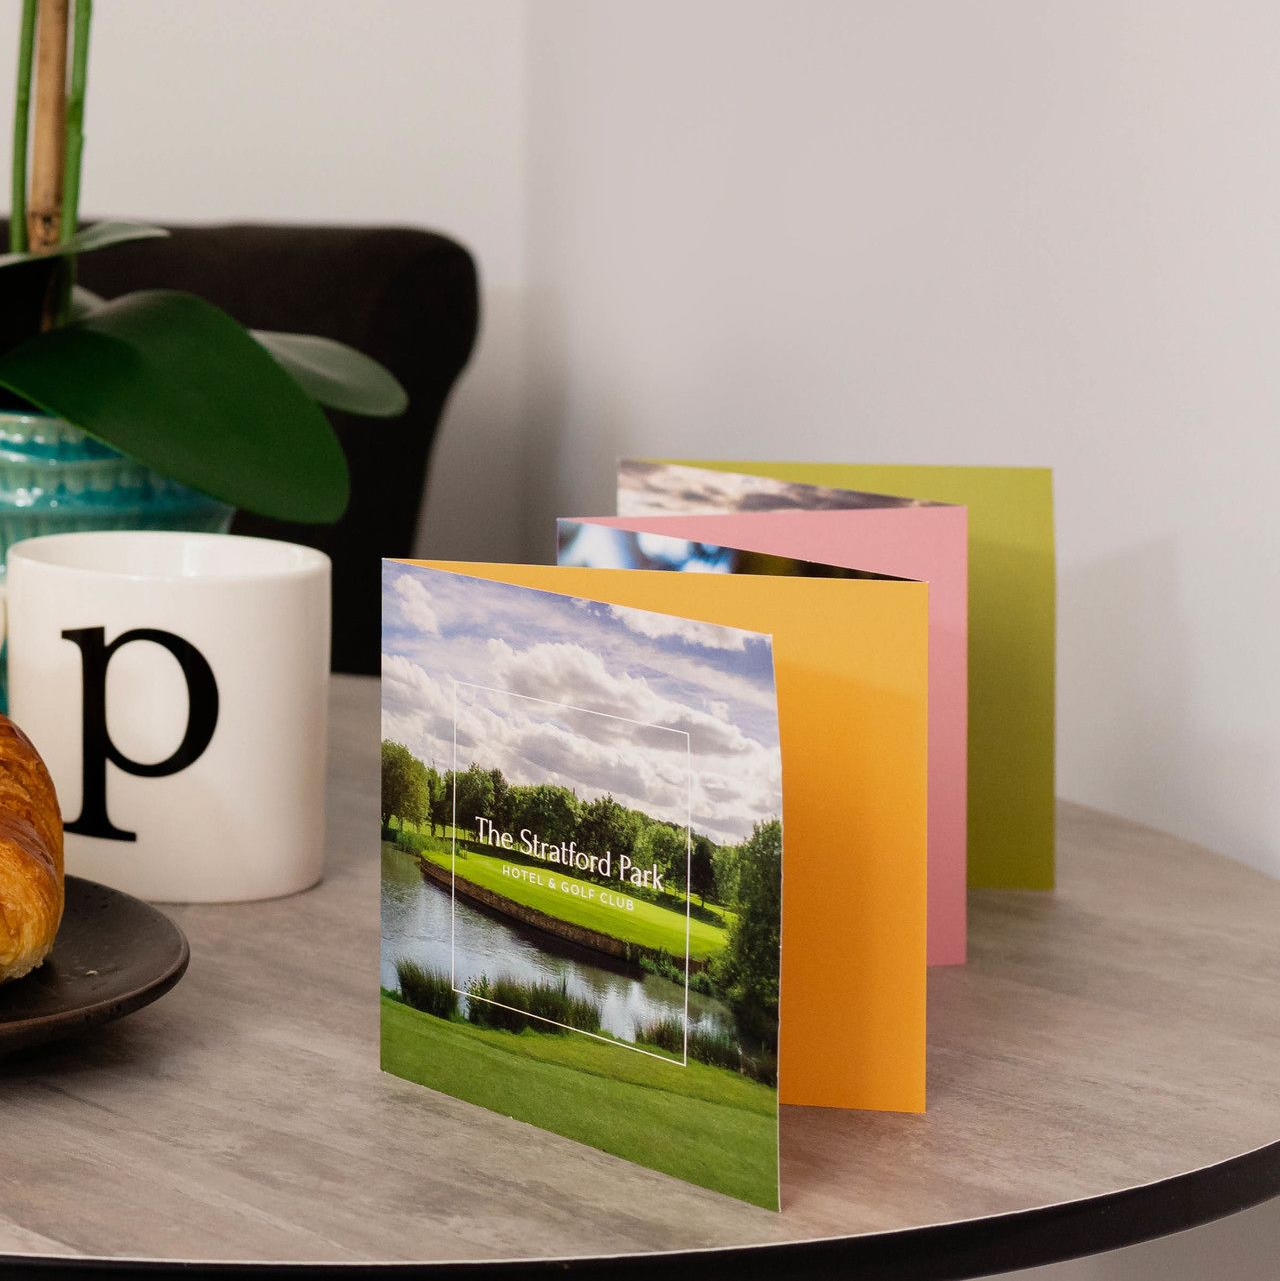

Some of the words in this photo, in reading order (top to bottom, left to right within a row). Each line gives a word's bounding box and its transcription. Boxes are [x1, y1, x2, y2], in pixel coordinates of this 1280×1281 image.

[61, 626, 219, 842] p
[475, 816, 513, 850] The
[520, 828, 611, 878] Stratford
[620, 854, 665, 891] Park
[502, 864, 544, 887] HOTEL
[548, 877, 556, 888] &
[561, 881, 595, 899] GOLF
[600, 892, 635, 911] CLUB
